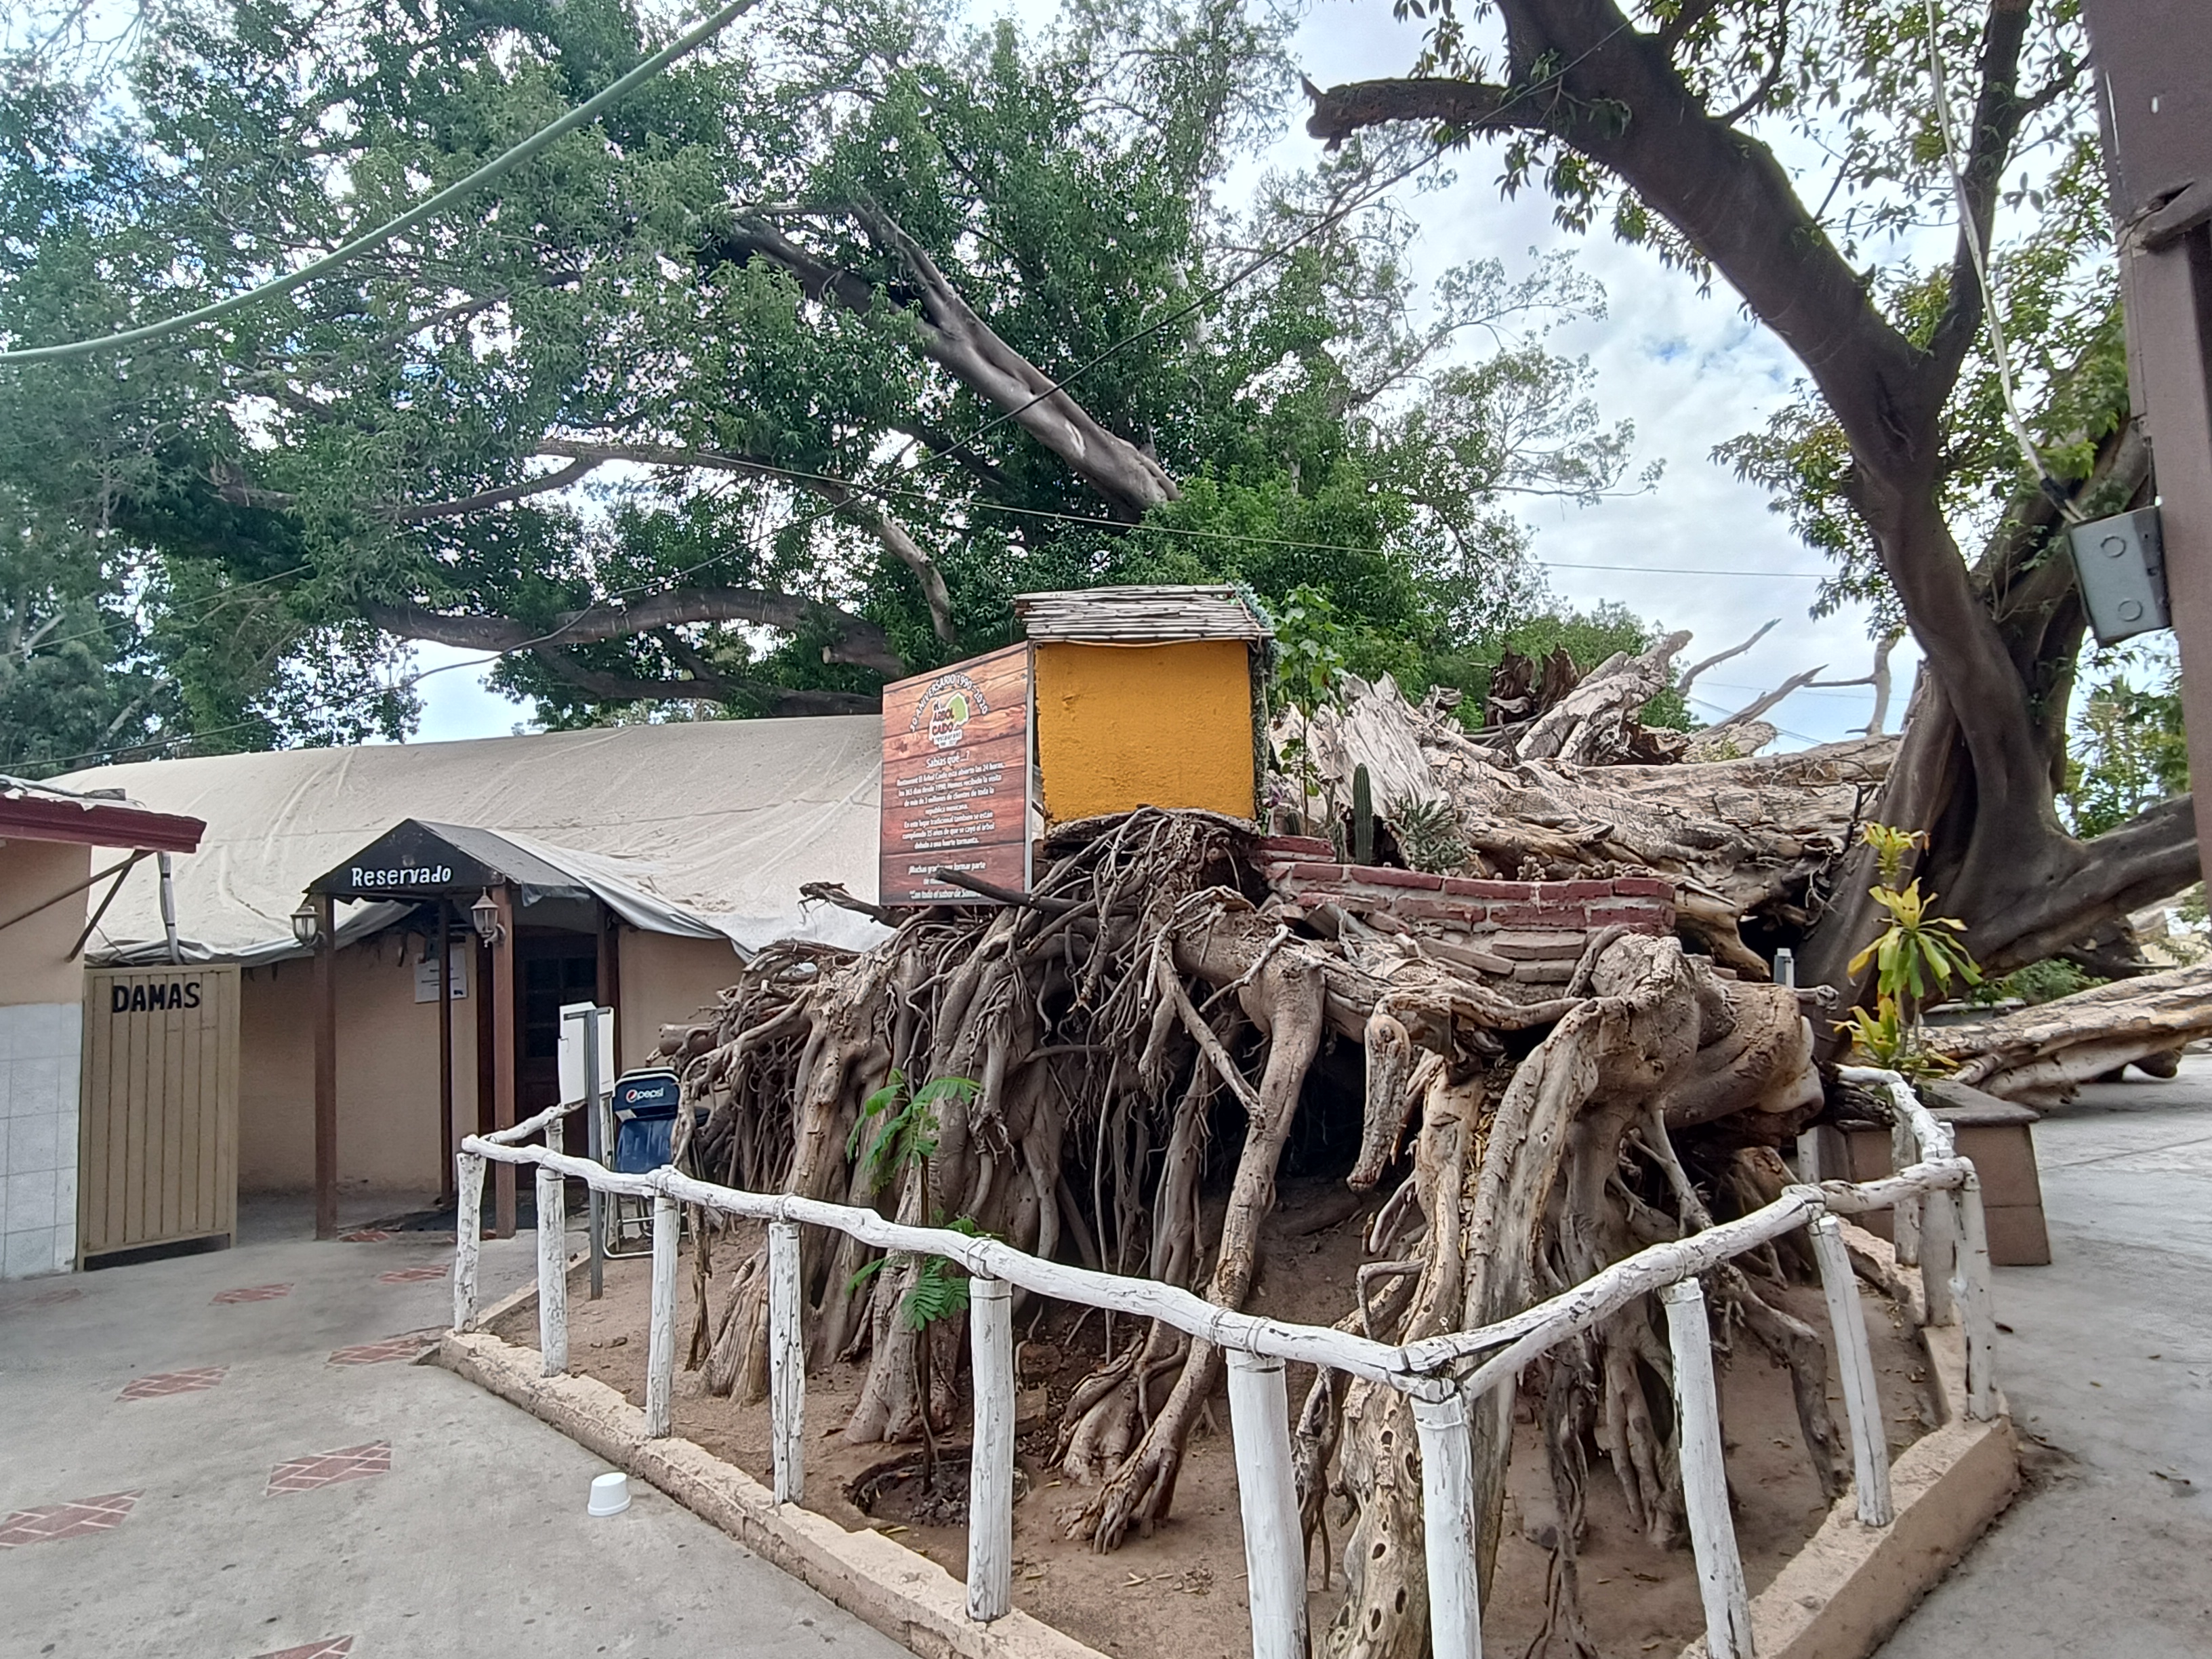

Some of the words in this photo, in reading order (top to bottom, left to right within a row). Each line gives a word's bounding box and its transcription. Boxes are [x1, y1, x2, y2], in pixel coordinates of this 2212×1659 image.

[916, 674, 956, 718] ANIVERSARIO
[351, 865, 452, 887] Reservado
[112, 982, 201, 1013] DAMAS
[637, 1087, 664, 1100] pepsi
